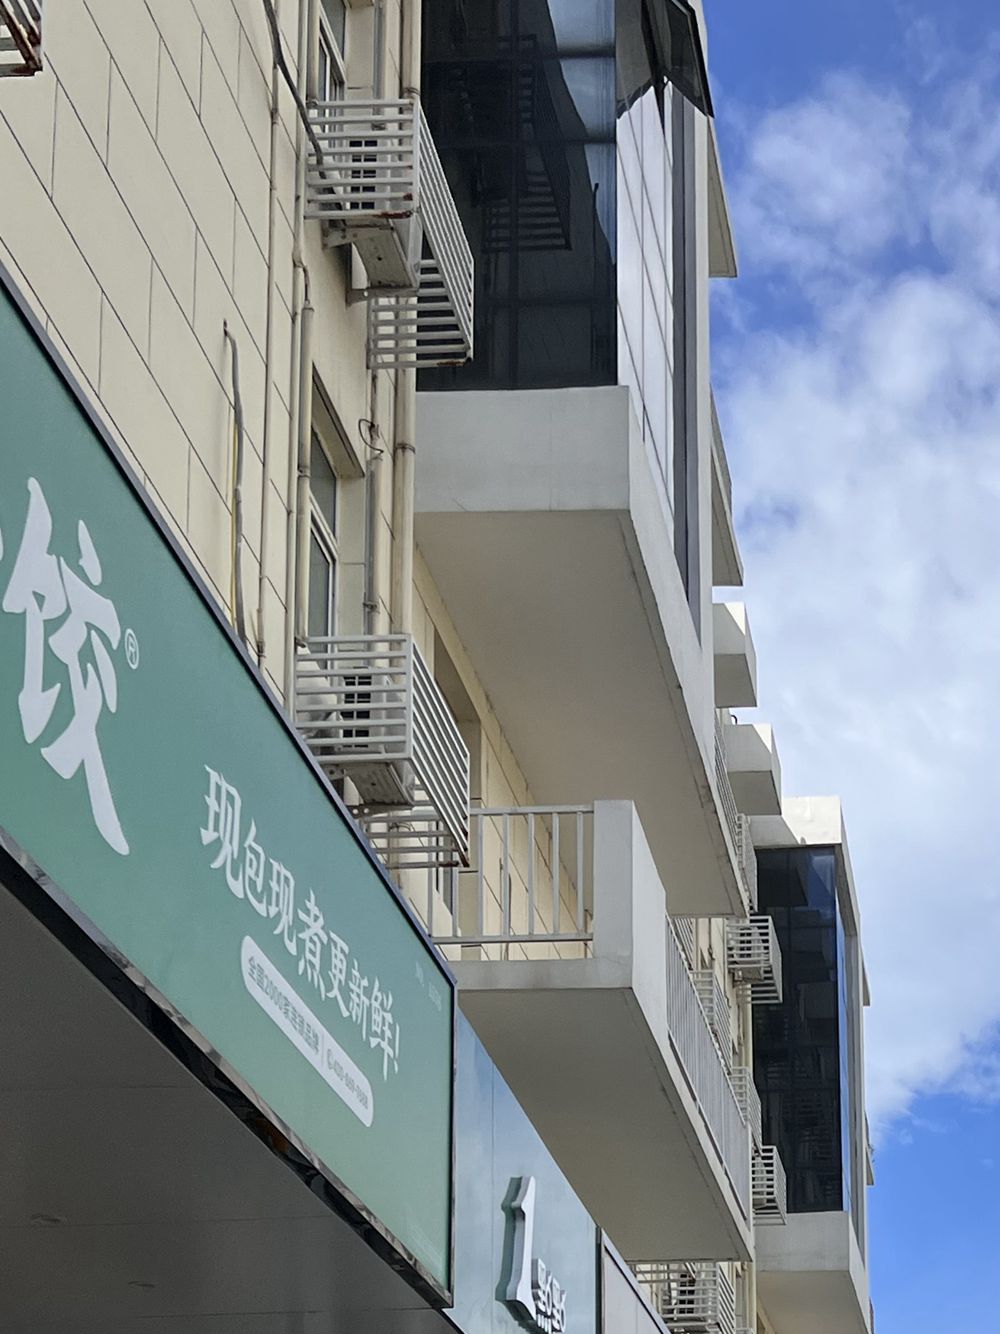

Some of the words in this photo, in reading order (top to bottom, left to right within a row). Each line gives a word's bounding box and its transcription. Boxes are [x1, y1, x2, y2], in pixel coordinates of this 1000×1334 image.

[199, 764, 400, 1081] 现包现煮更新鲜!
